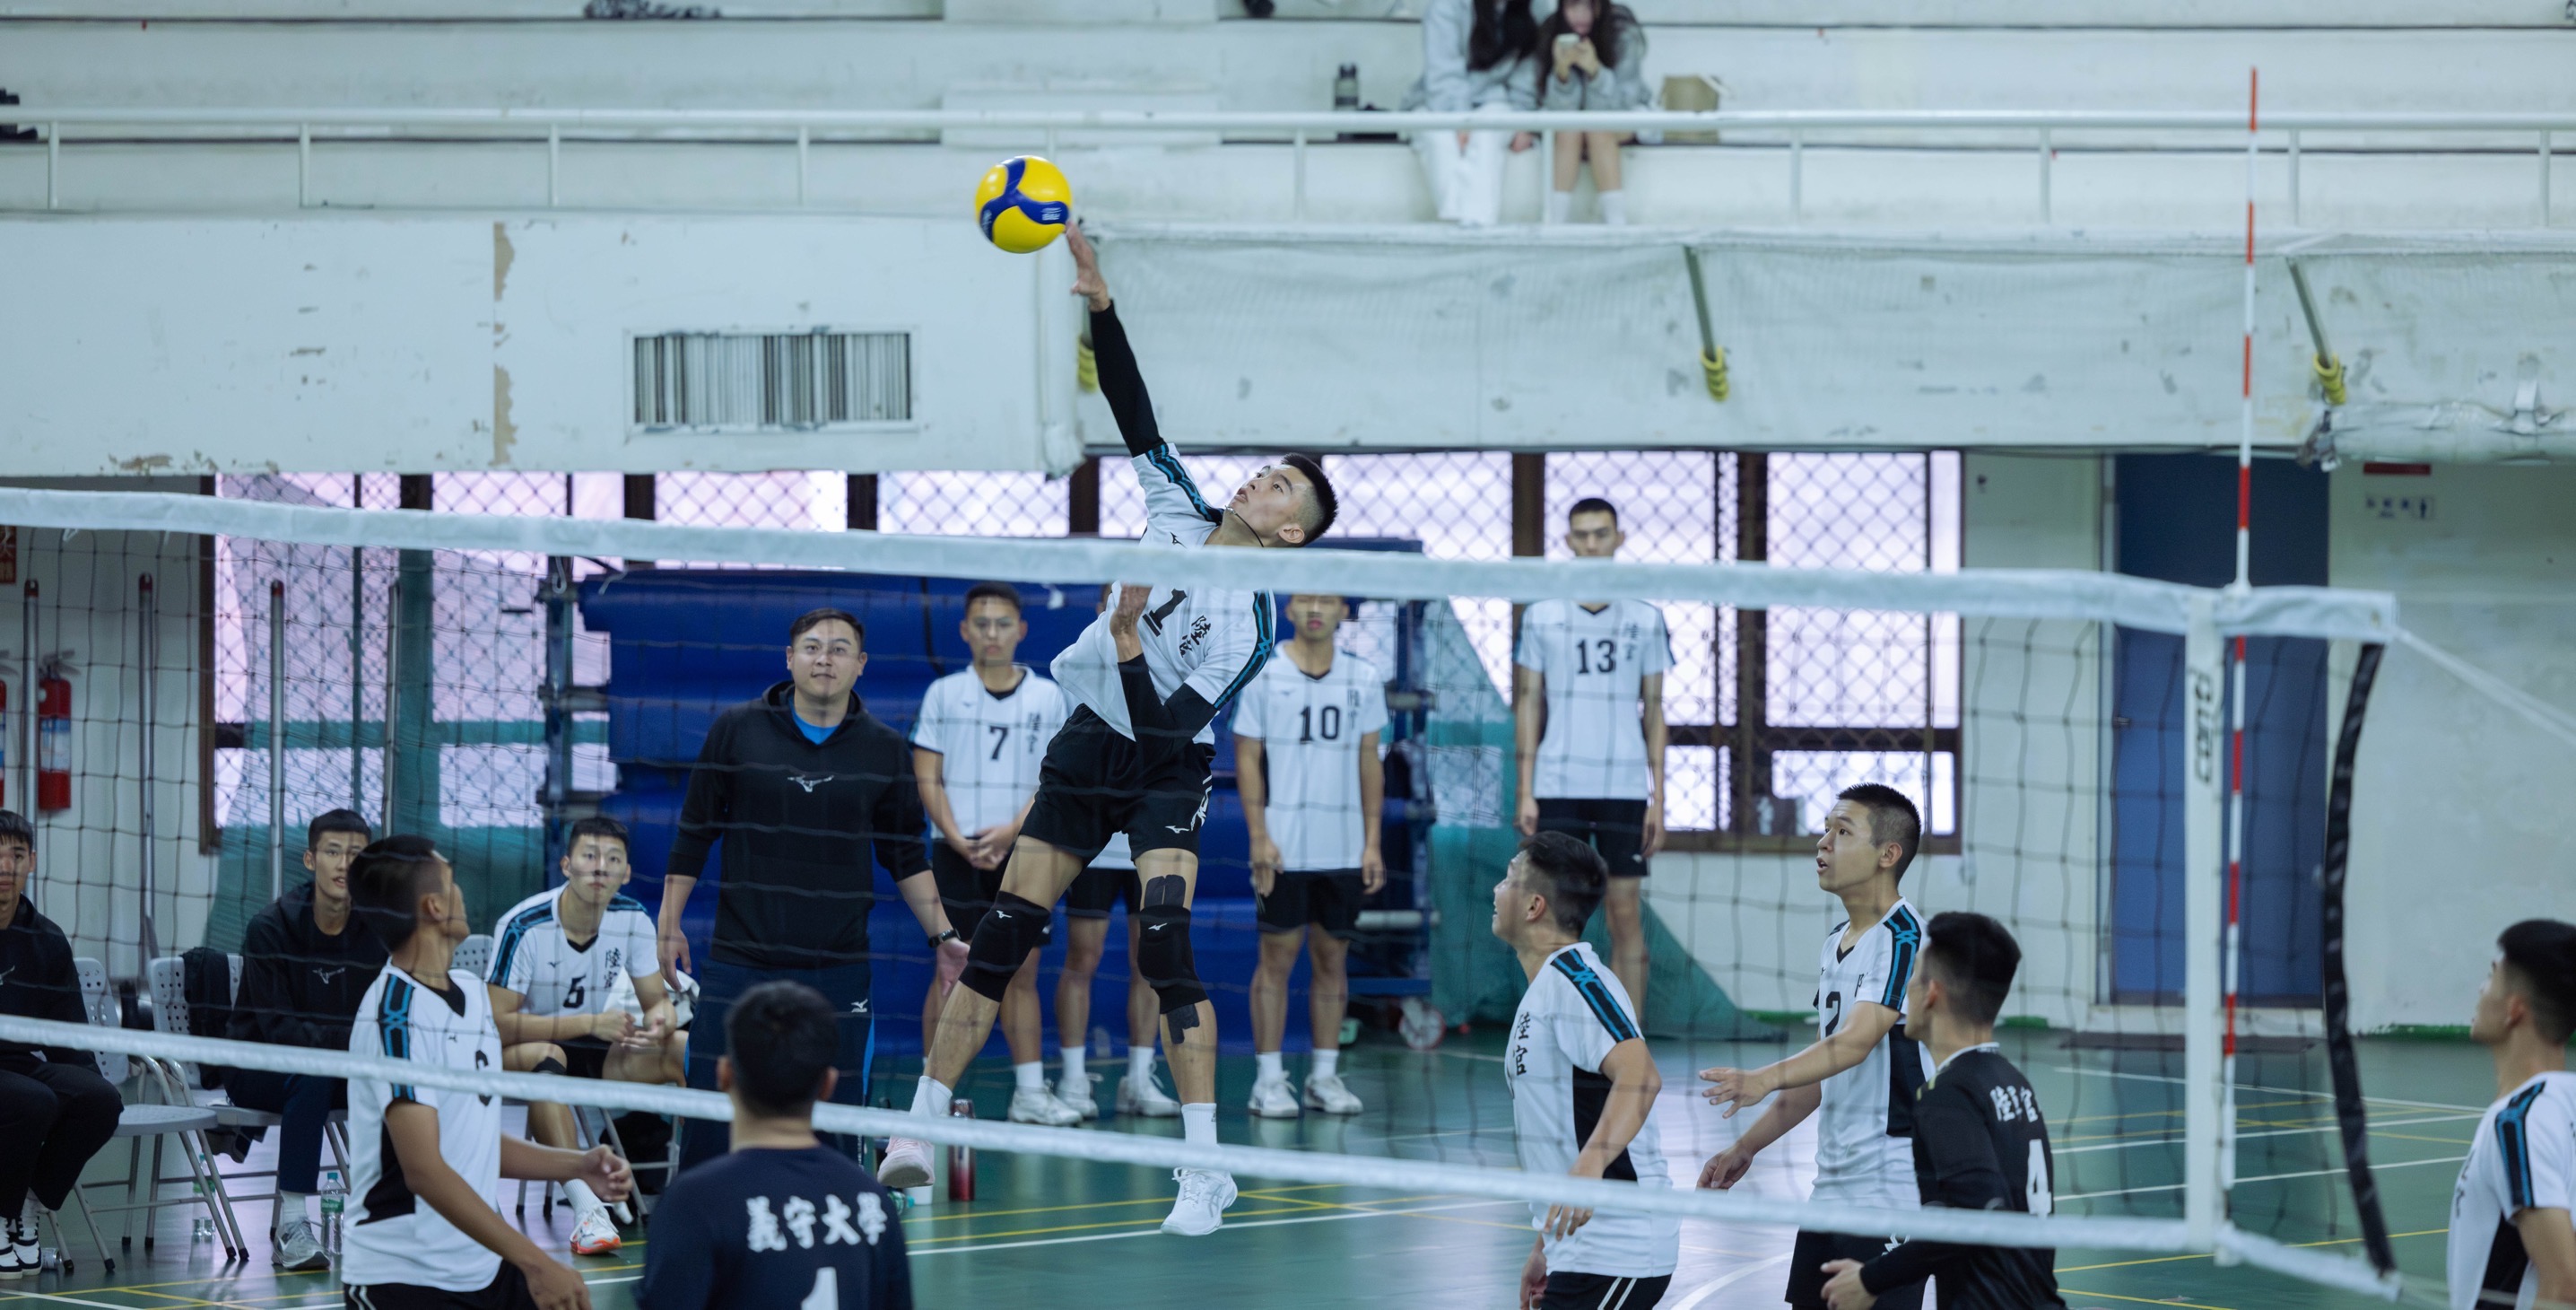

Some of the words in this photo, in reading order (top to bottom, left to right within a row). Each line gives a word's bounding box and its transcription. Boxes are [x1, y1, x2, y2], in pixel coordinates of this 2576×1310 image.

[1149, 589, 1188, 631] 1
[1576, 639, 1617, 675] 13
[989, 724, 1009, 760] 7
[1299, 705, 1340, 744] 10
[562, 974, 587, 1009] 5
[1825, 991, 1841, 1038] 2
[1513, 1011, 1531, 1076] 陸官
[2026, 1139, 2052, 1216] 4
[745, 1192, 888, 1253] 義守大學
